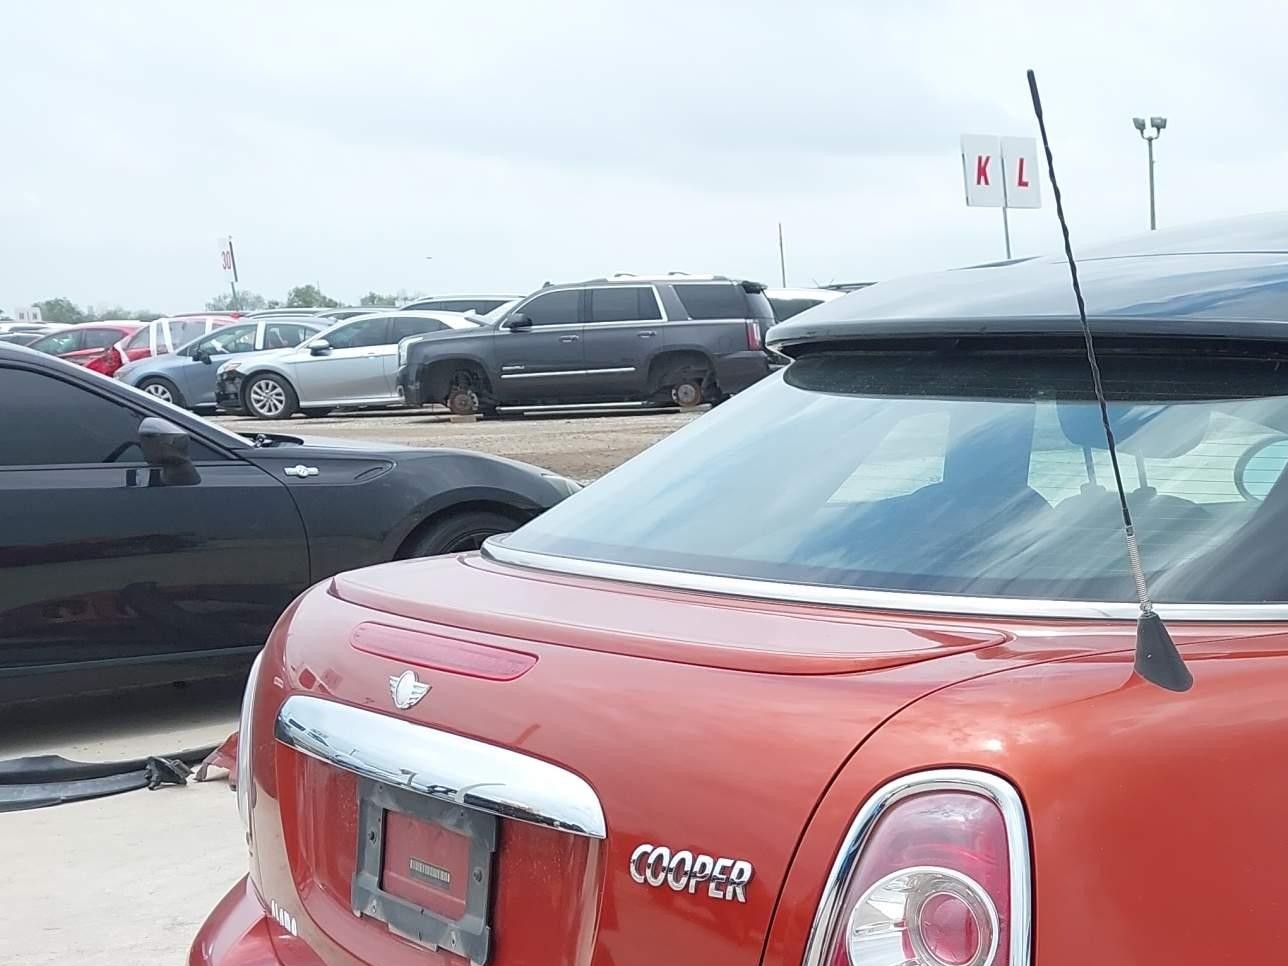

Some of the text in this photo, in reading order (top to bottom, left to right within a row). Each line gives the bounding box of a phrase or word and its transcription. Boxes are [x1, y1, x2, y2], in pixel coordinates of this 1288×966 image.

[976, 155, 990, 186] K
[1017, 157, 1029, 187] L
[629, 843, 752, 903] COOPER
